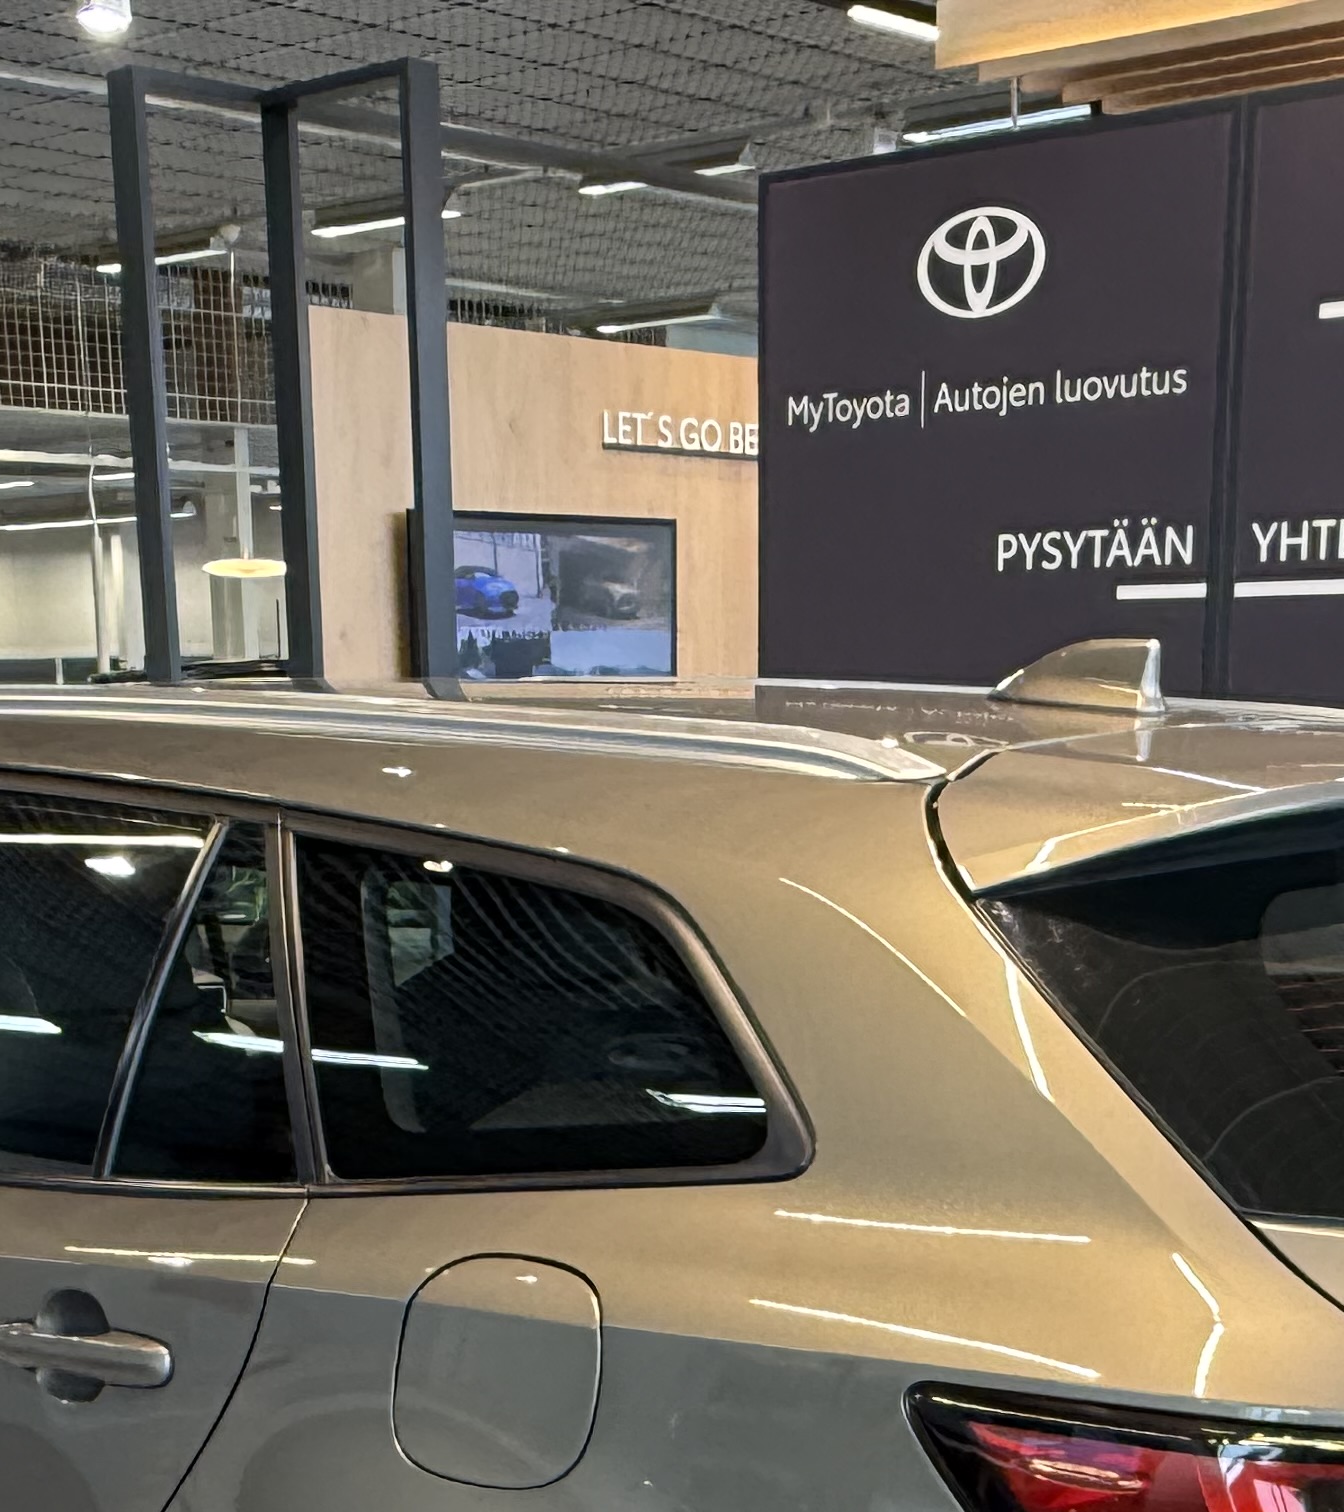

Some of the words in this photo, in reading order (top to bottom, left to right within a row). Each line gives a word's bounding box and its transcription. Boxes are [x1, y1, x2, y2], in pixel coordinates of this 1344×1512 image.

[787, 389, 910, 432] MyToyota
[933, 375, 1045, 416] Autojen
[1055, 366, 1188, 404] luovutus
[679, 417, 722, 452] GO
[997, 516, 1194, 572] PYSYTÄÄN
